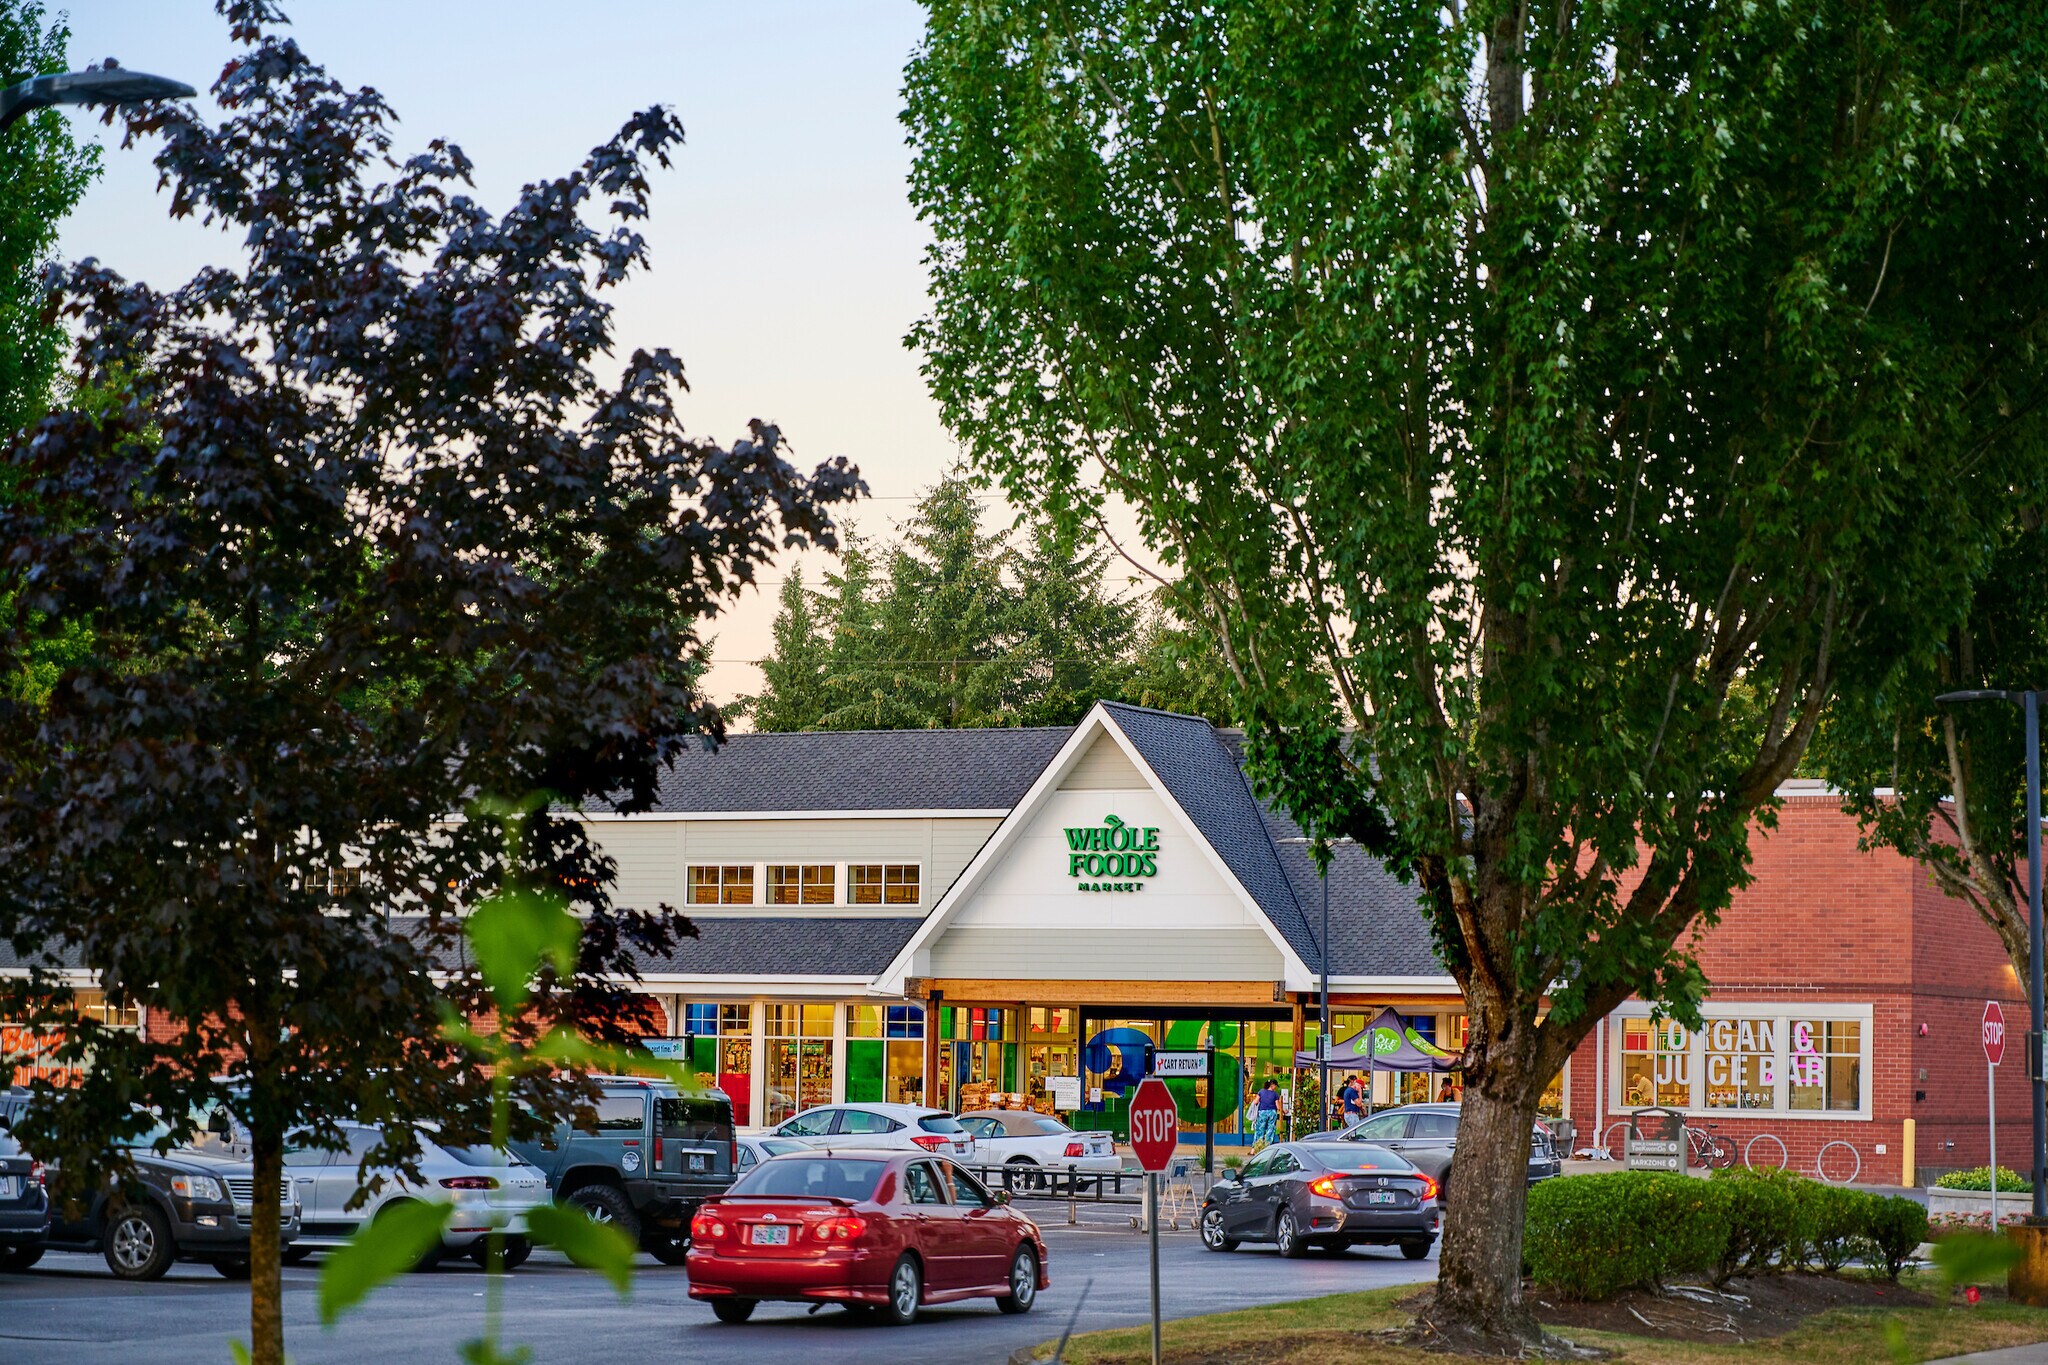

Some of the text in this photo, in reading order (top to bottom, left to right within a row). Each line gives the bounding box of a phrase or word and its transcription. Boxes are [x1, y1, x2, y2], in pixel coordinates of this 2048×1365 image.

[1063, 815, 1159, 851] WHOLE
[1068, 853, 1157, 877] FOODS
[1078, 882, 1144, 892] MARKET
[1667, 1020, 1814, 1052] OGANC
[1985, 1022, 2003, 1046] STOP
[1164, 1059, 1177, 1070] CART
[1178, 1059, 1198, 1070] RETURN
[1657, 1054, 1825, 1088] JUCE BAR
[1709, 1093, 1770, 1101] CANEEN
[1133, 1109, 1174, 1143] STOP
[1631, 1159, 1667, 1167] BARKZONE
